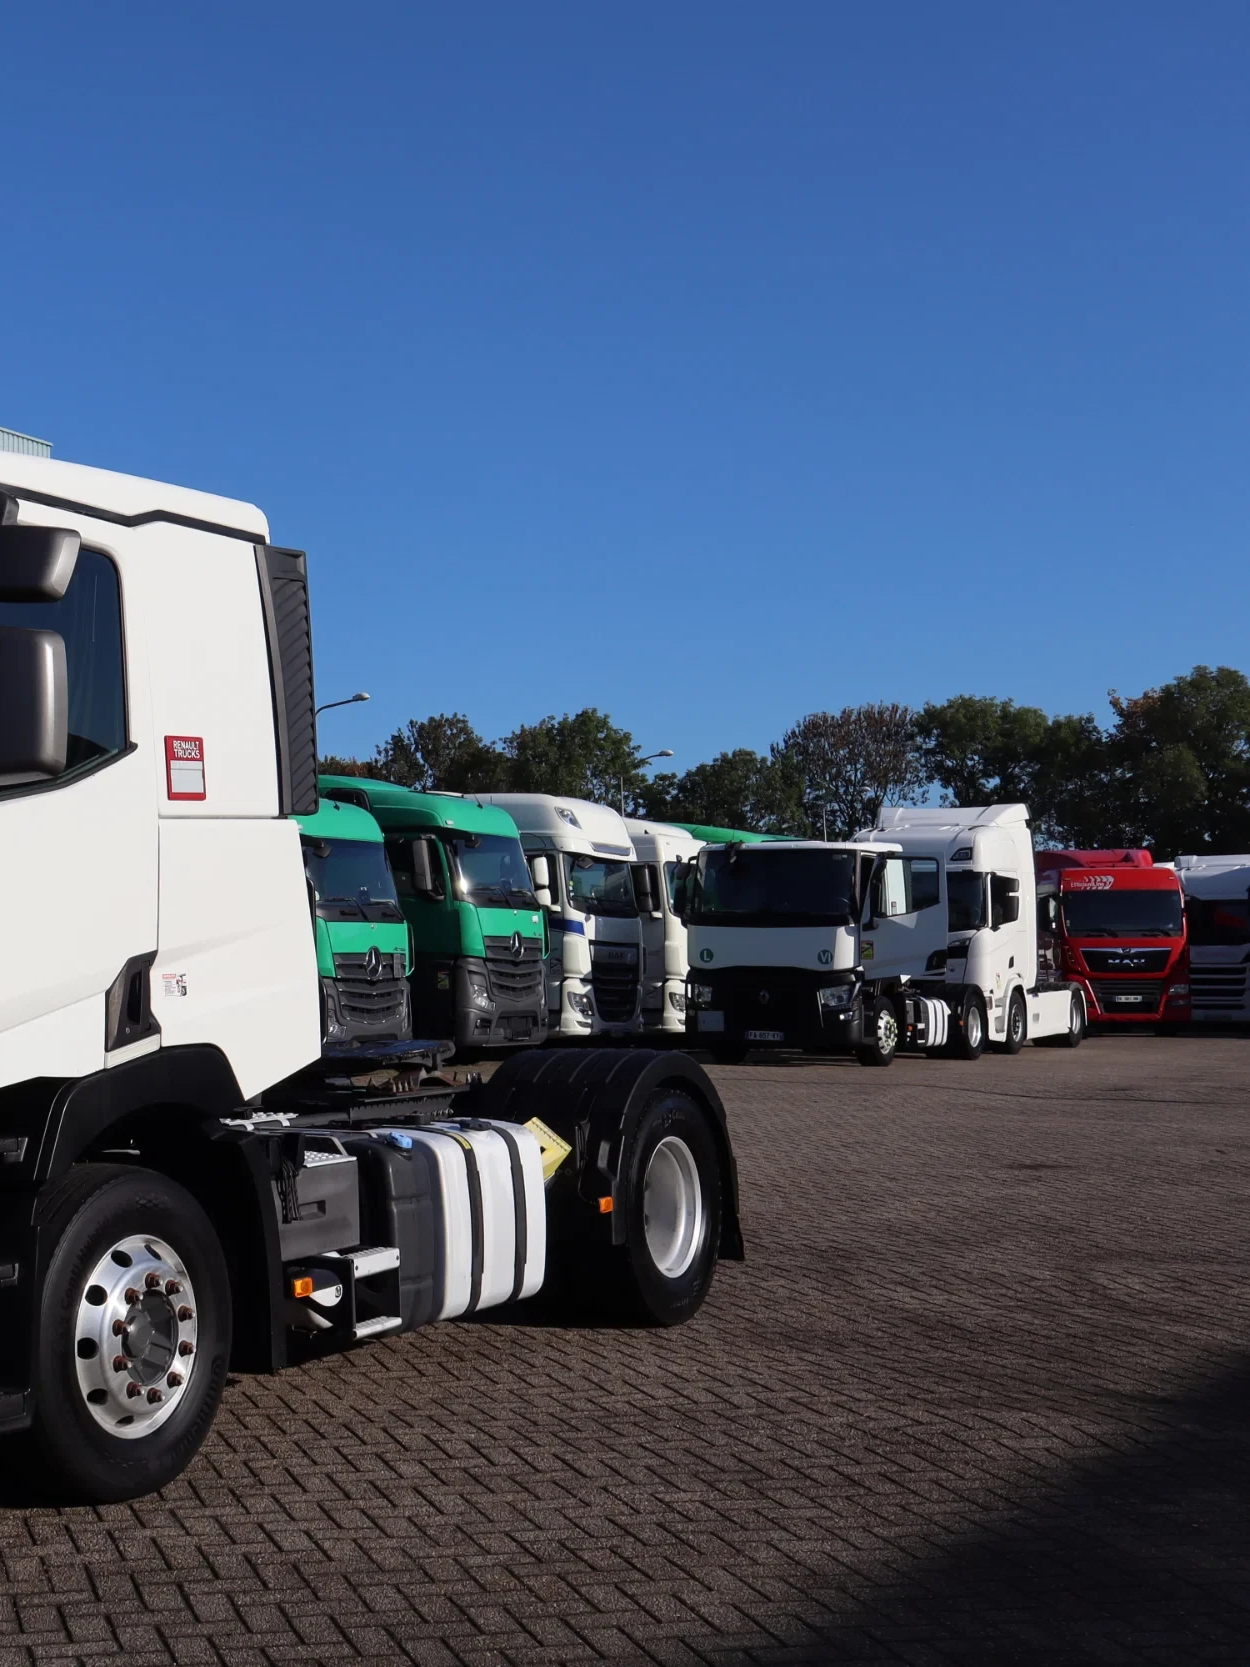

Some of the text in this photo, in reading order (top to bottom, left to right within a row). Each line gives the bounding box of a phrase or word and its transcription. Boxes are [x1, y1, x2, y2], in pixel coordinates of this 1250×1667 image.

[173, 740, 200, 750] RENAULT
[174, 749, 201, 759] TRUCKS
[703, 950, 711, 961] L
